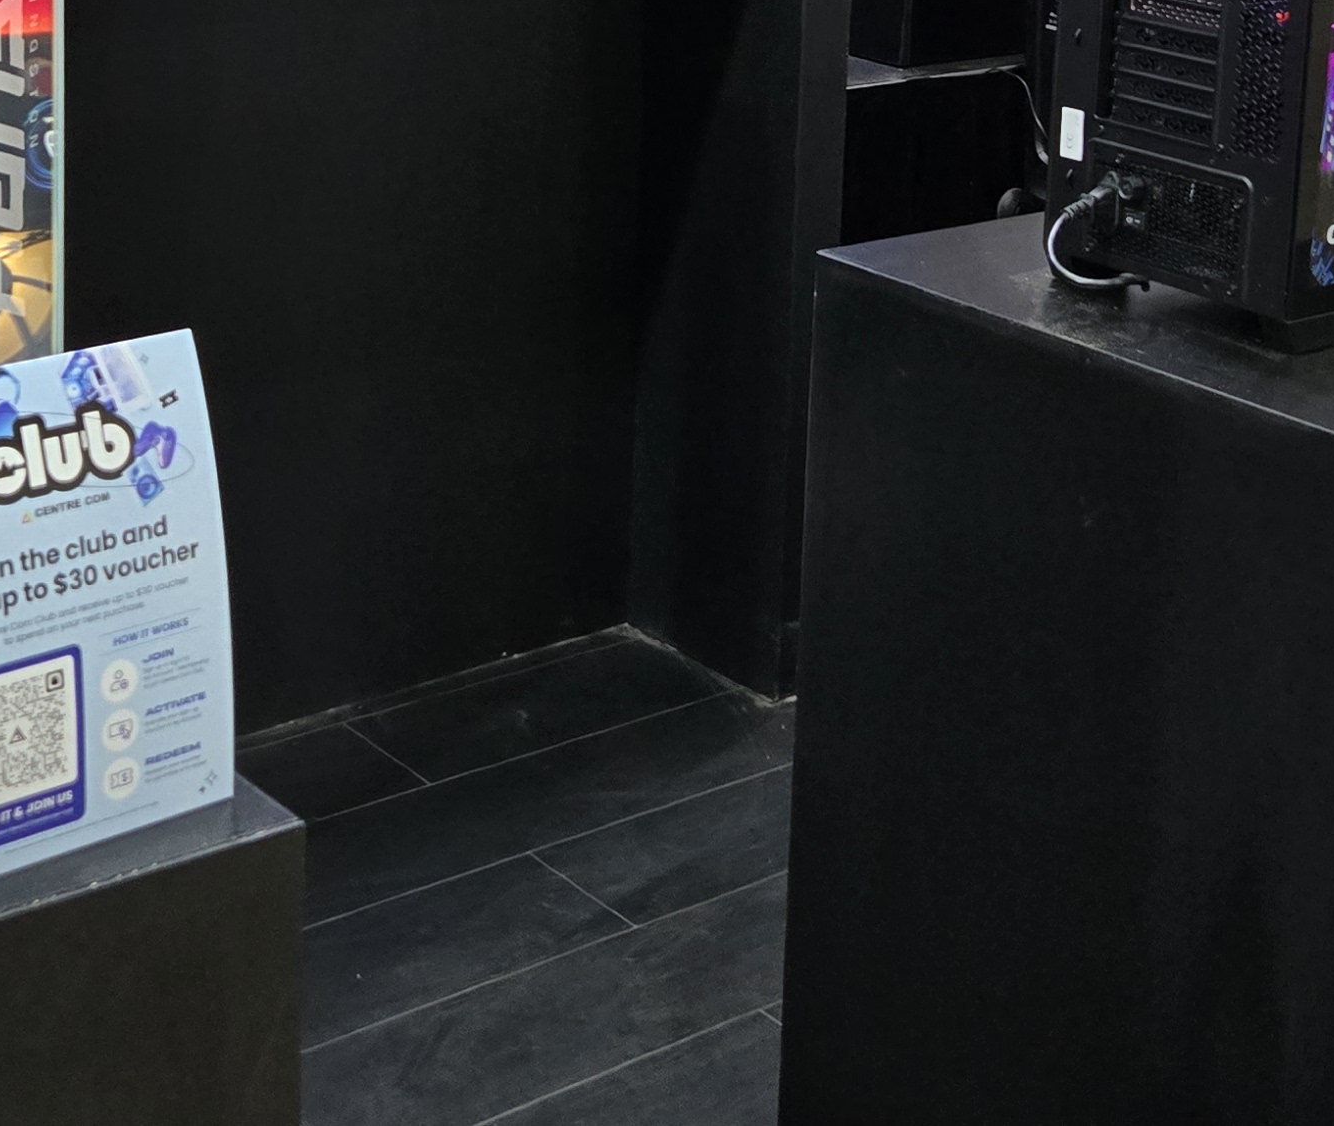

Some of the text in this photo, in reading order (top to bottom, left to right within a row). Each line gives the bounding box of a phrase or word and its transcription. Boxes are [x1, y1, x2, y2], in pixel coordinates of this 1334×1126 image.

[34, 492, 111, 519] CENTRE COM
[19, 546, 61, 579] the
[65, 531, 118, 569] club
[122, 515, 168, 547] and
[23, 580, 48, 605] to
[54, 564, 97, 597] $30
[102, 539, 200, 580] voucher
[33, 612, 57, 625] Club
[58, 606, 77, 619] and
[113, 617, 190, 646] HOW IT WORKS
[141, 647, 174, 664] JOIN
[145, 691, 207, 717] ACTIVATE
[144, 741, 201, 766] REDEEM
[0, 808, 12, 823] IT
[13, 804, 24, 817] &
[25, 795, 56, 815] JOIN
[57, 789, 74, 805] US
